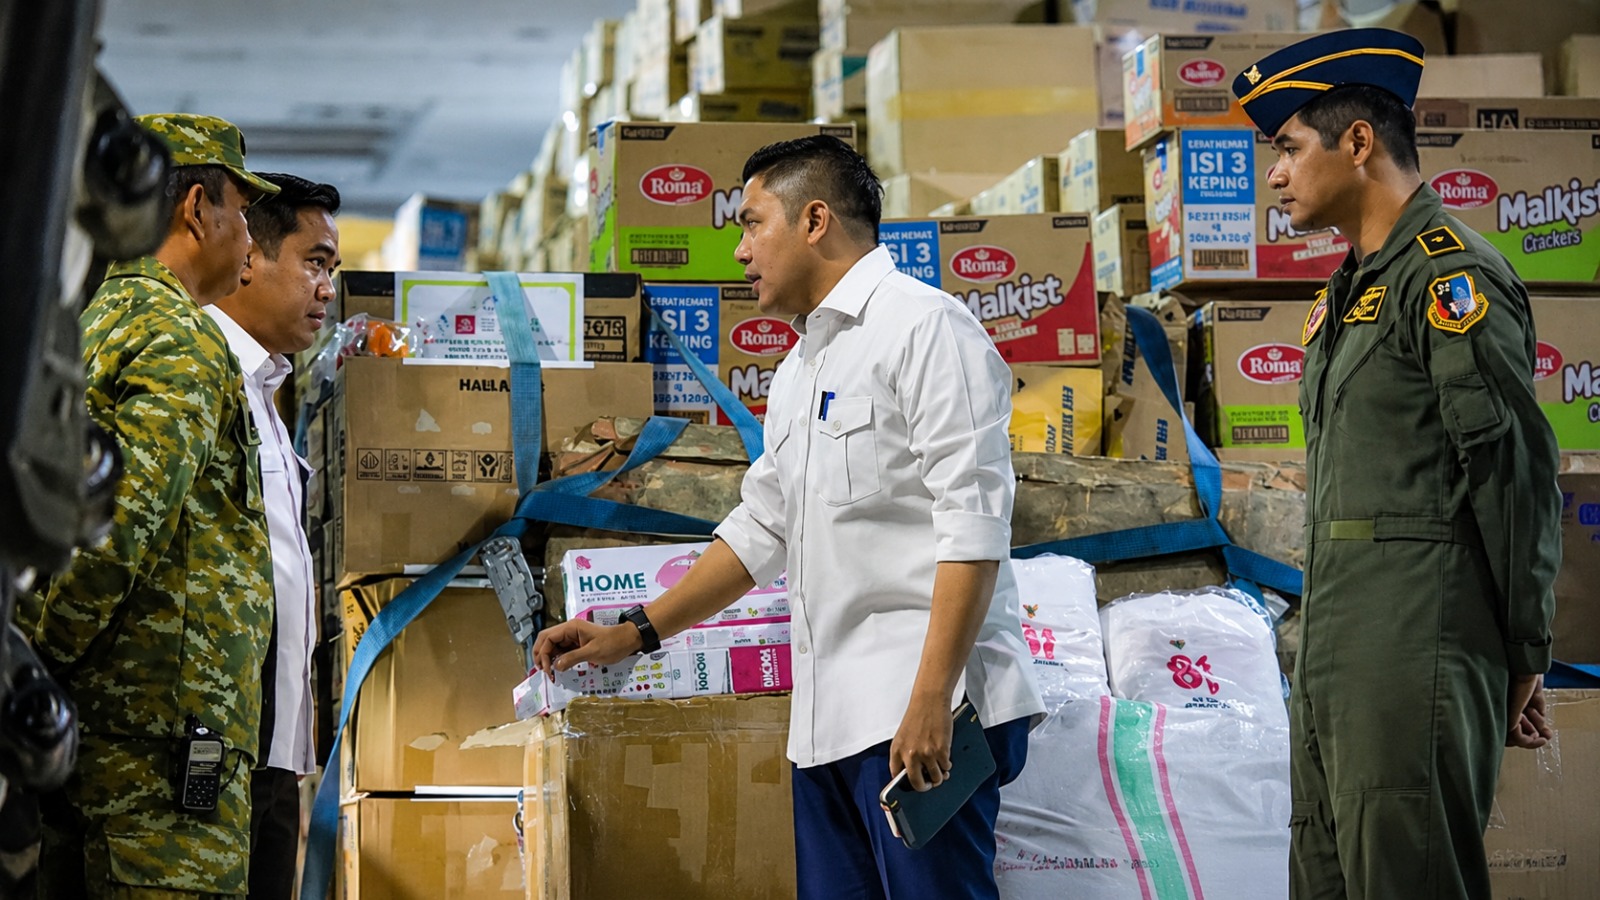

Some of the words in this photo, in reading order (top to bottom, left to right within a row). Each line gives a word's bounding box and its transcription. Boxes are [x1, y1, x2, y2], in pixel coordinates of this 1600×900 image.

[1190, 151, 1223, 174] ISI
[1231, 151, 1247, 174] 3
[650, 178, 703, 195] Roma
[1188, 176, 1249, 190] KEPING
[1438, 182, 1489, 199] Roma
[1523, 229, 1581, 253] Crackers
[888, 243, 908, 264] SI
[915, 242, 932, 264] 3
[959, 258, 1008, 273] Roma
[694, 309, 710, 332] 3
[740, 329, 789, 346] Roma
[1250, 357, 1302, 375] Roma
[579, 572, 647, 593] HOME
